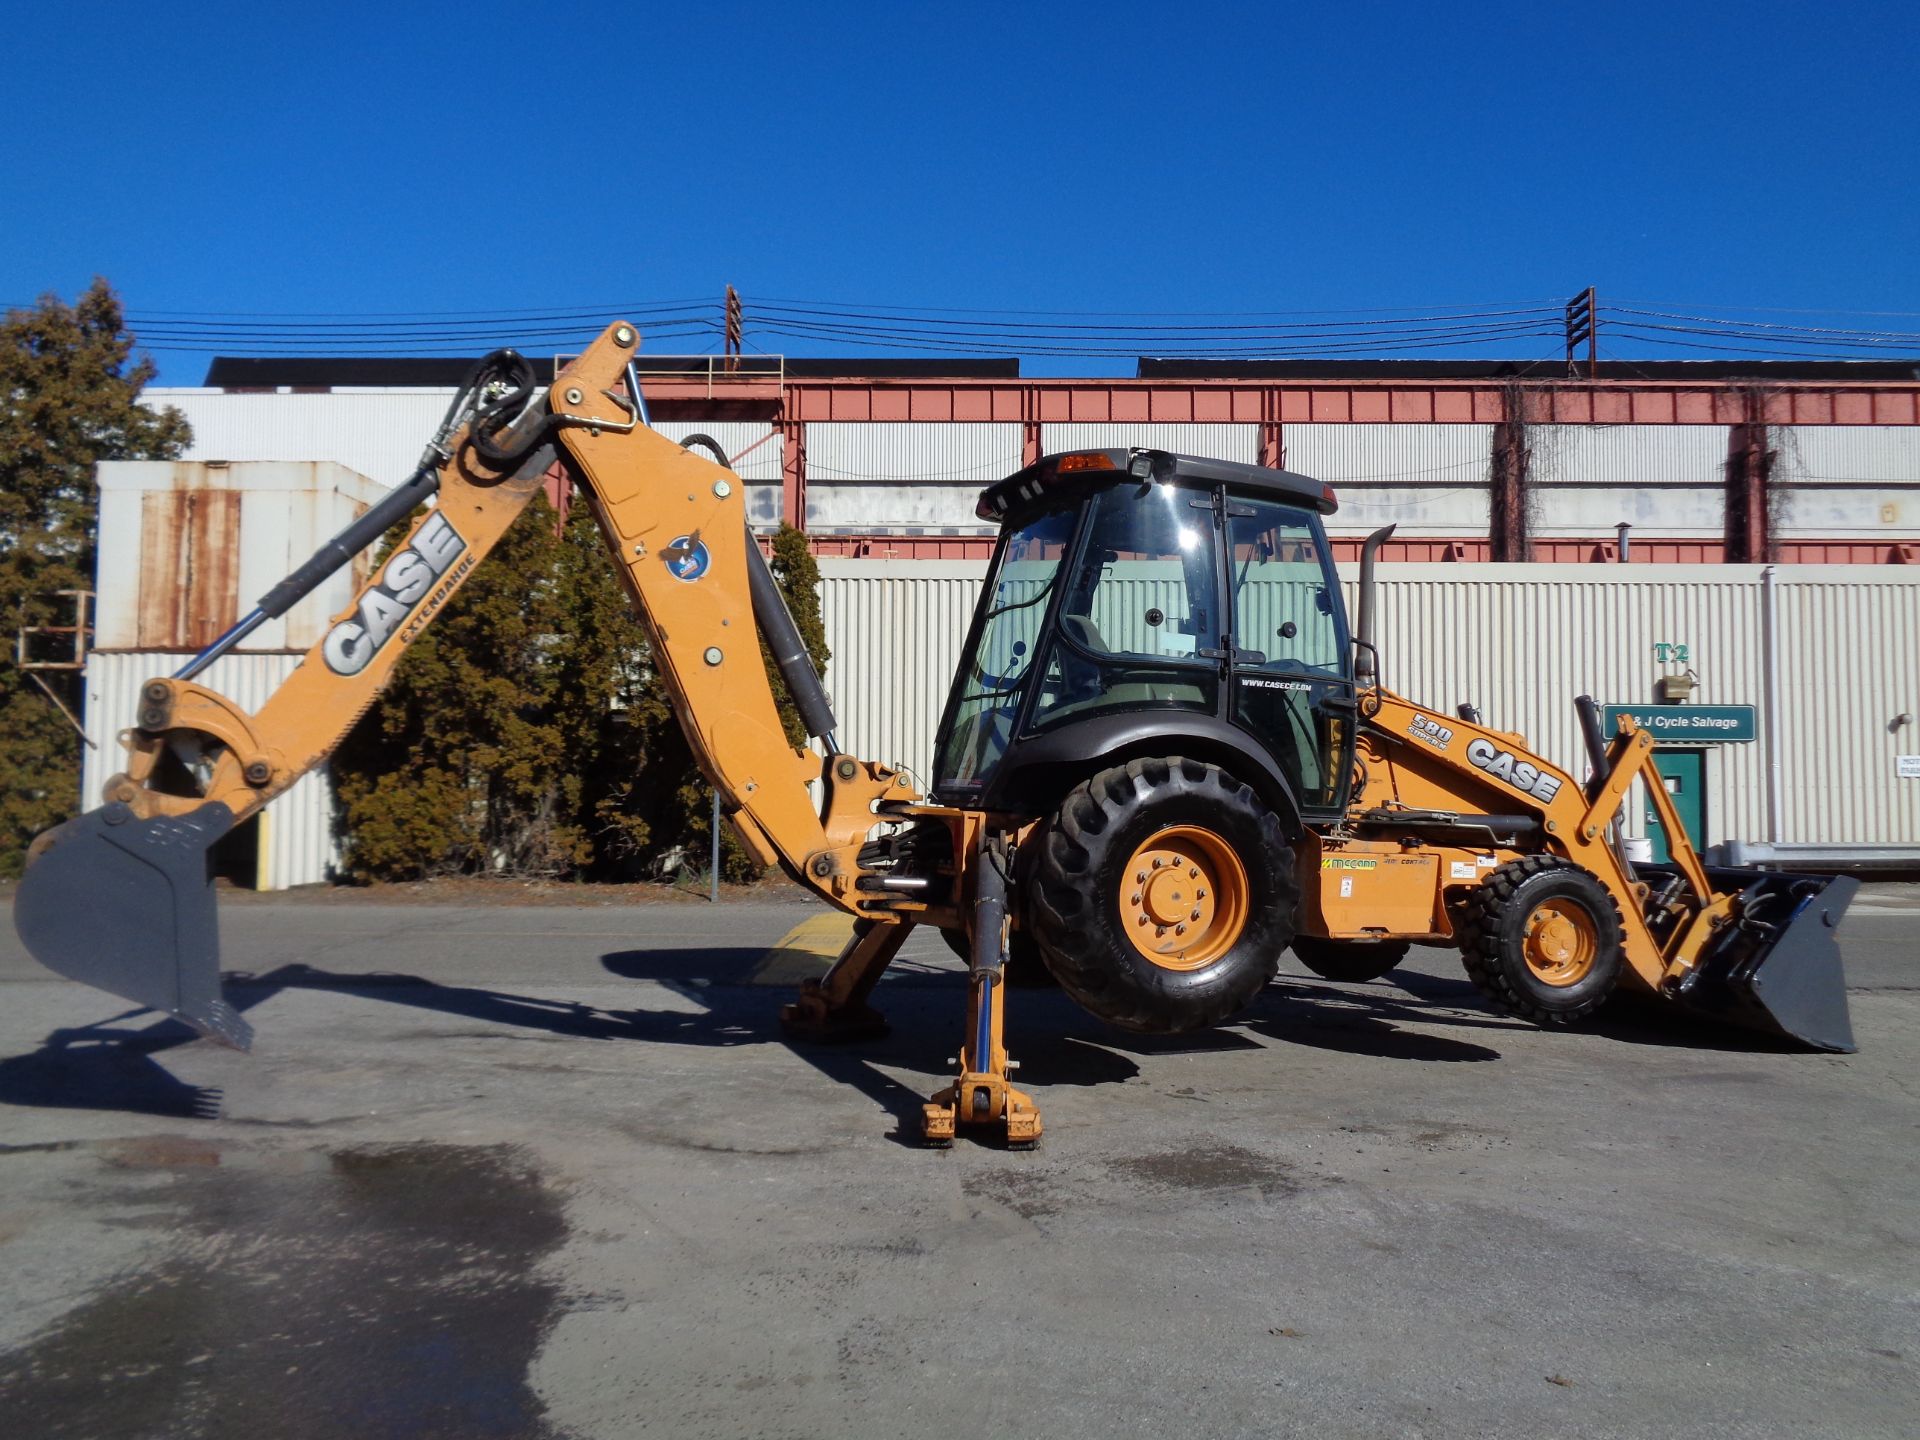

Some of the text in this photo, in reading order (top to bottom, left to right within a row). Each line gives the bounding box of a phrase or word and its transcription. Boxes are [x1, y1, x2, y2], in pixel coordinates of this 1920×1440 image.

[322, 509, 467, 676] CASE
[400, 553, 476, 643] EXTENDAHOE
[1412, 712, 1453, 743] 580
[1633, 716, 1739, 730] & J Cycle Salvage
[1466, 737, 1563, 805] CASE
